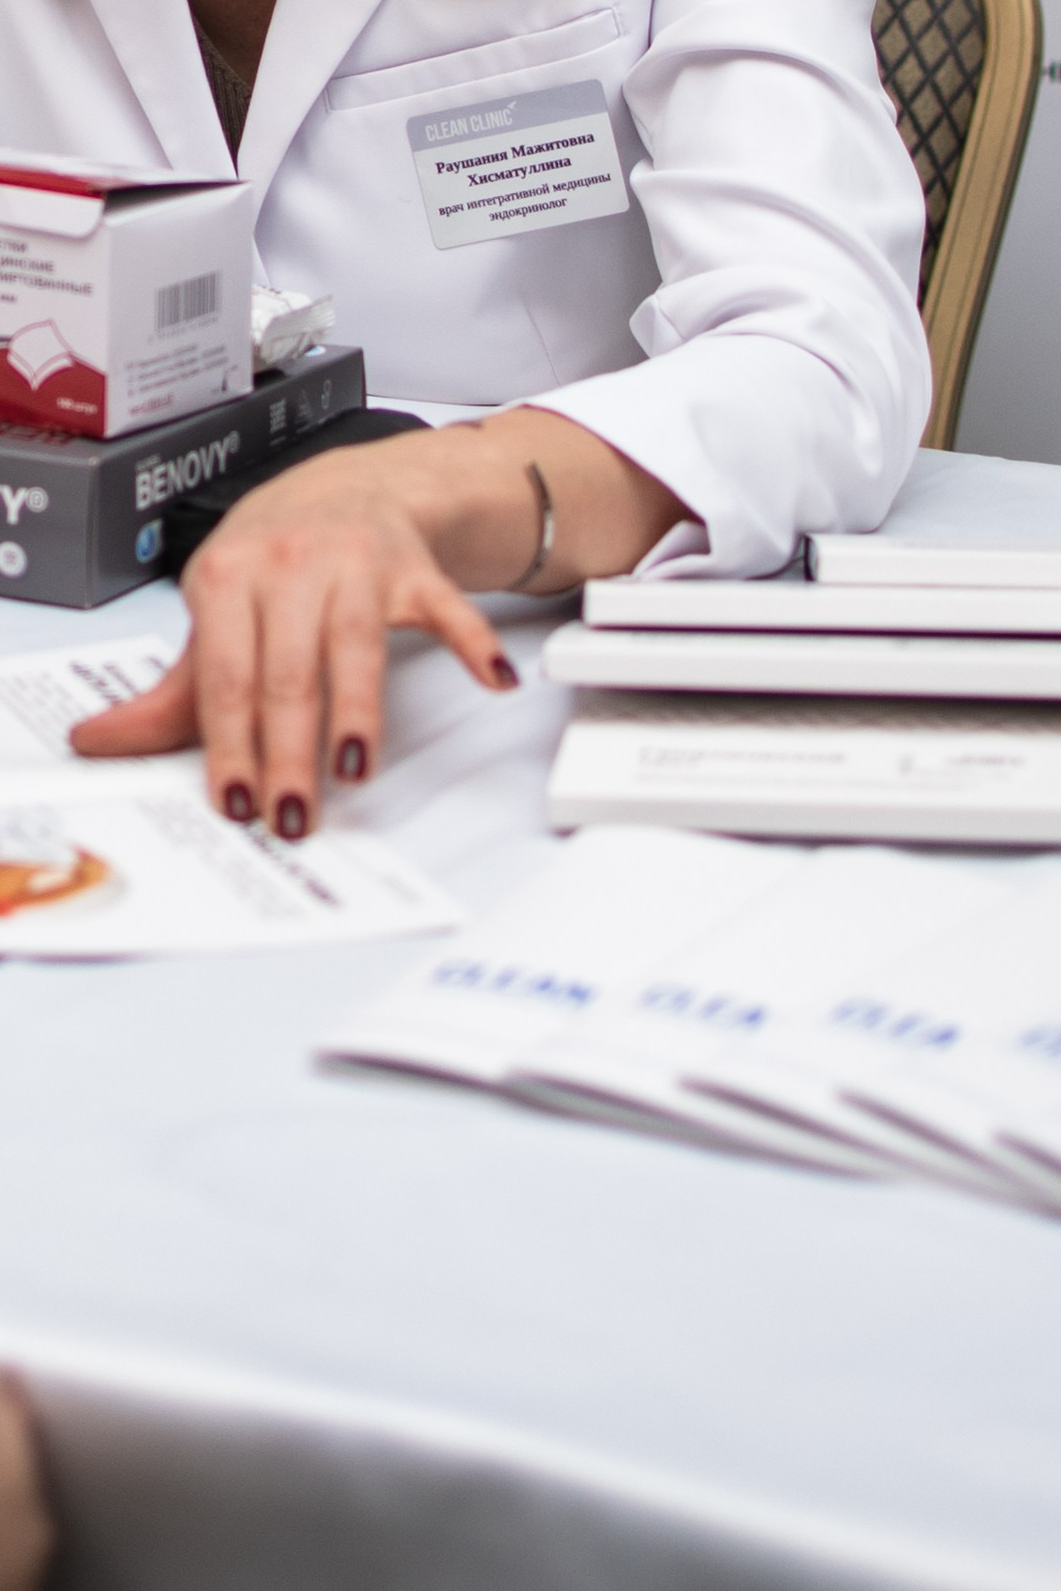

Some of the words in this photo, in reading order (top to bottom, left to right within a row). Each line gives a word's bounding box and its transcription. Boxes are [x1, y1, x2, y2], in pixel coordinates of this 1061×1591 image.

[425, 118, 469, 142] CLEAN
[470, 108, 514, 133] CLINIC
[435, 149, 509, 175] Раушания
[510, 132, 595, 160] Мажитовна
[467, 156, 572, 187] Хисматуллина
[438, 202, 465, 218] врач
[466, 183, 551, 212] интегративной
[552, 172, 612, 194] медицины
[488, 197, 568, 223] эндокринолог
